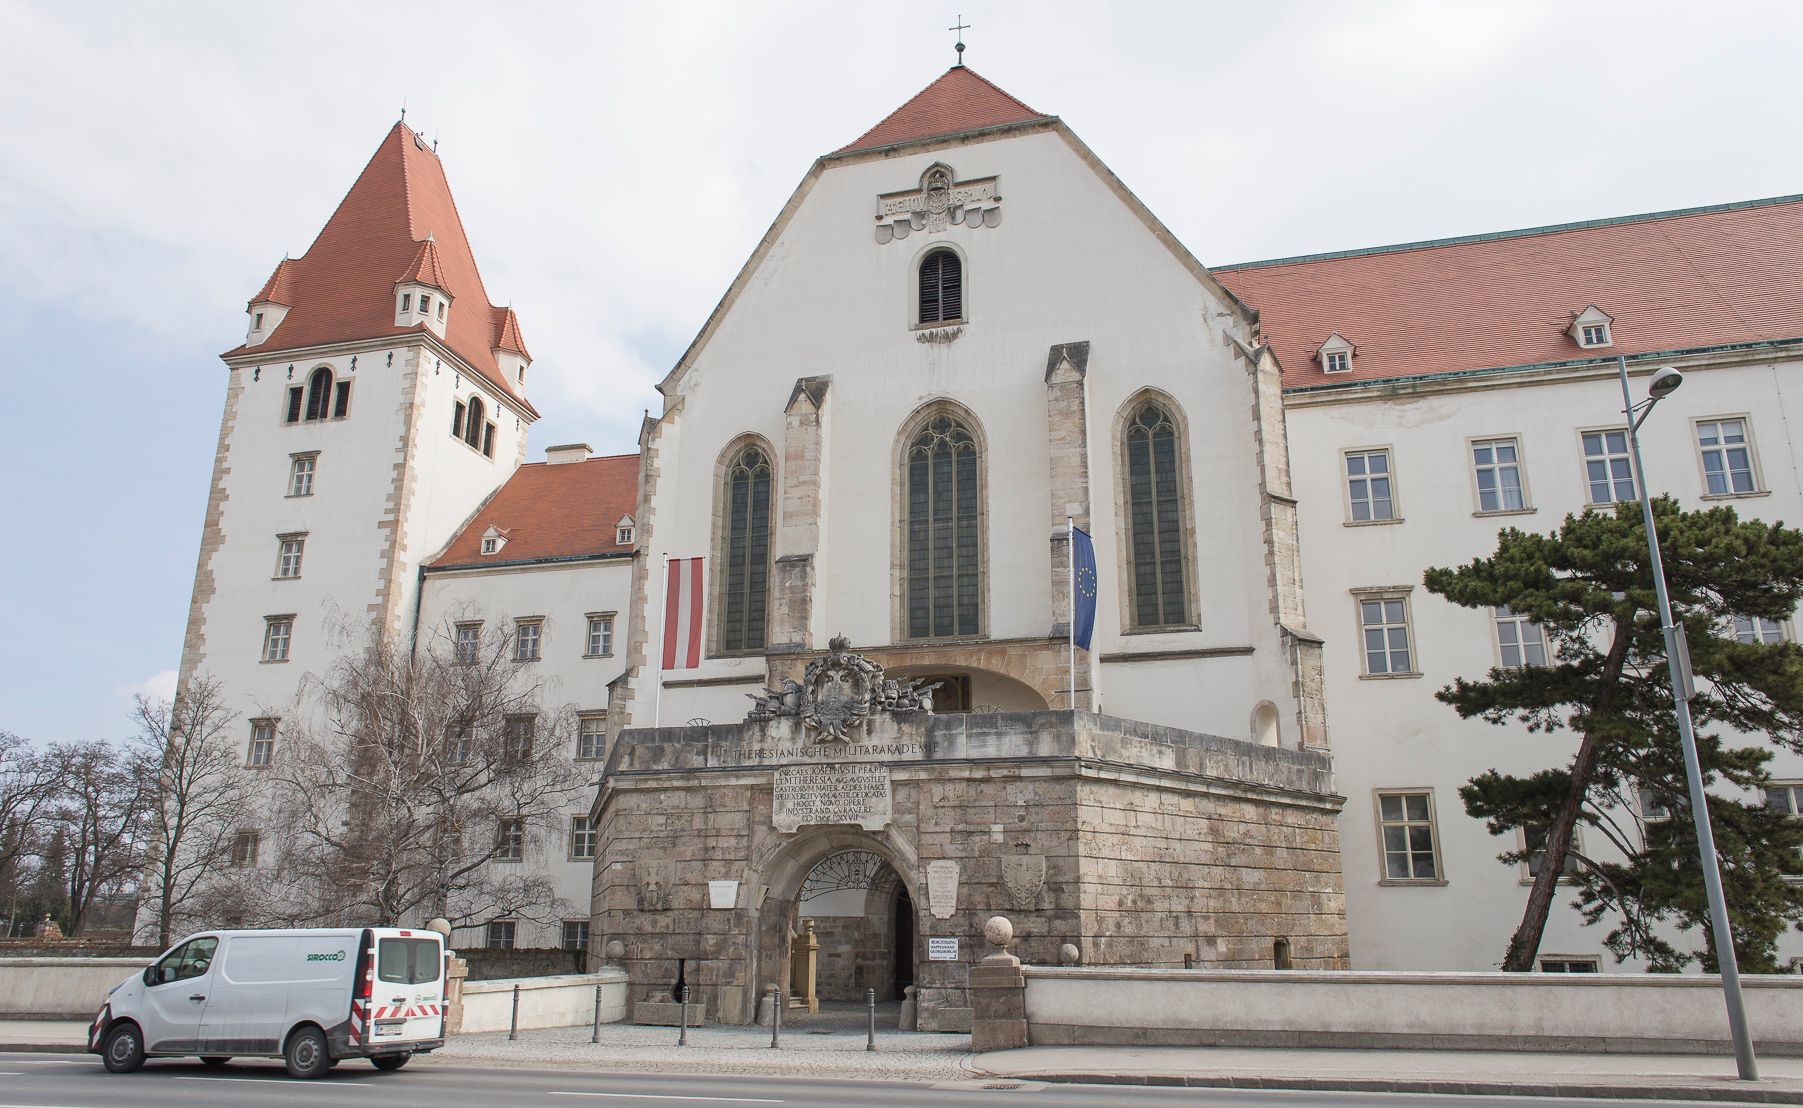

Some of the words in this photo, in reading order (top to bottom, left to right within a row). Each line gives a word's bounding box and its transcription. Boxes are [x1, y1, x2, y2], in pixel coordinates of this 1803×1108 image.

[733, 746, 829, 760] THERESIANISCHE
[833, 743, 939, 756] MILITÄRAKADEMIE
[306, 953, 339, 961] SIROCCO
